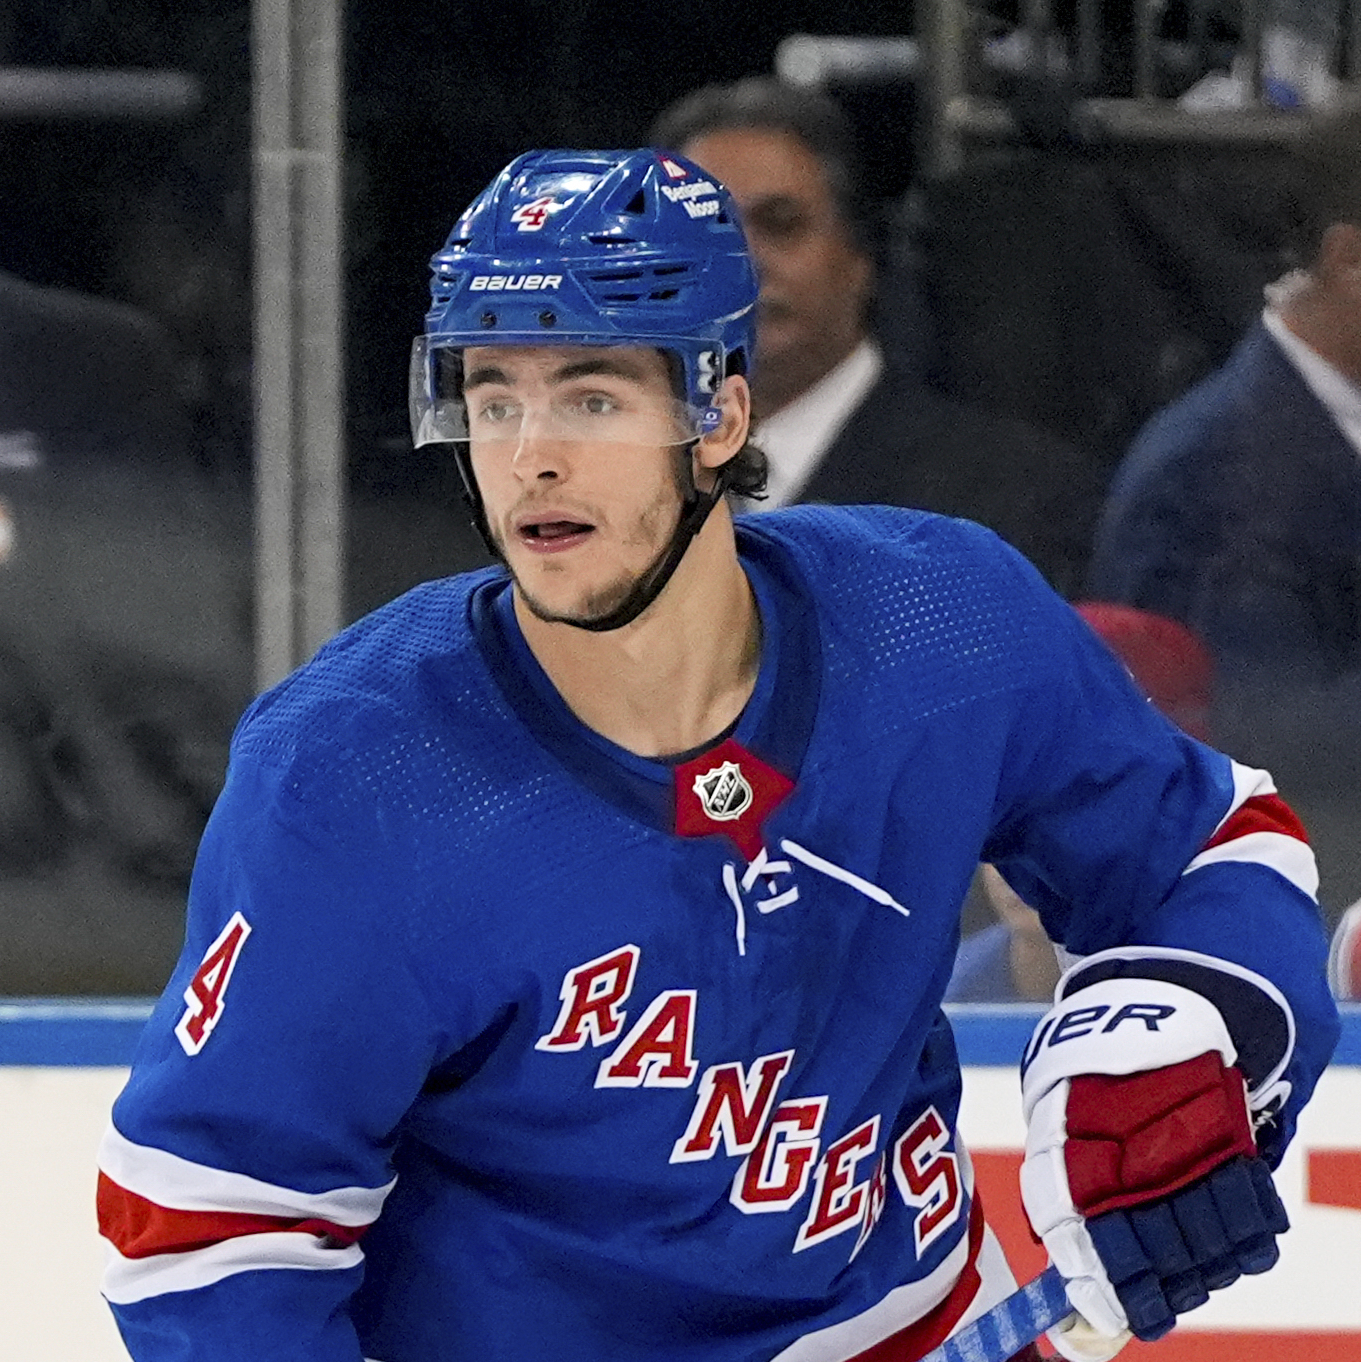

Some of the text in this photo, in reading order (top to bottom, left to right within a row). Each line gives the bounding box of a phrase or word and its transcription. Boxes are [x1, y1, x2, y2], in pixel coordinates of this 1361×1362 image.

[509, 196, 555, 232] 4
[468, 274, 564, 291] BAUER
[174, 910, 253, 1057] 4
